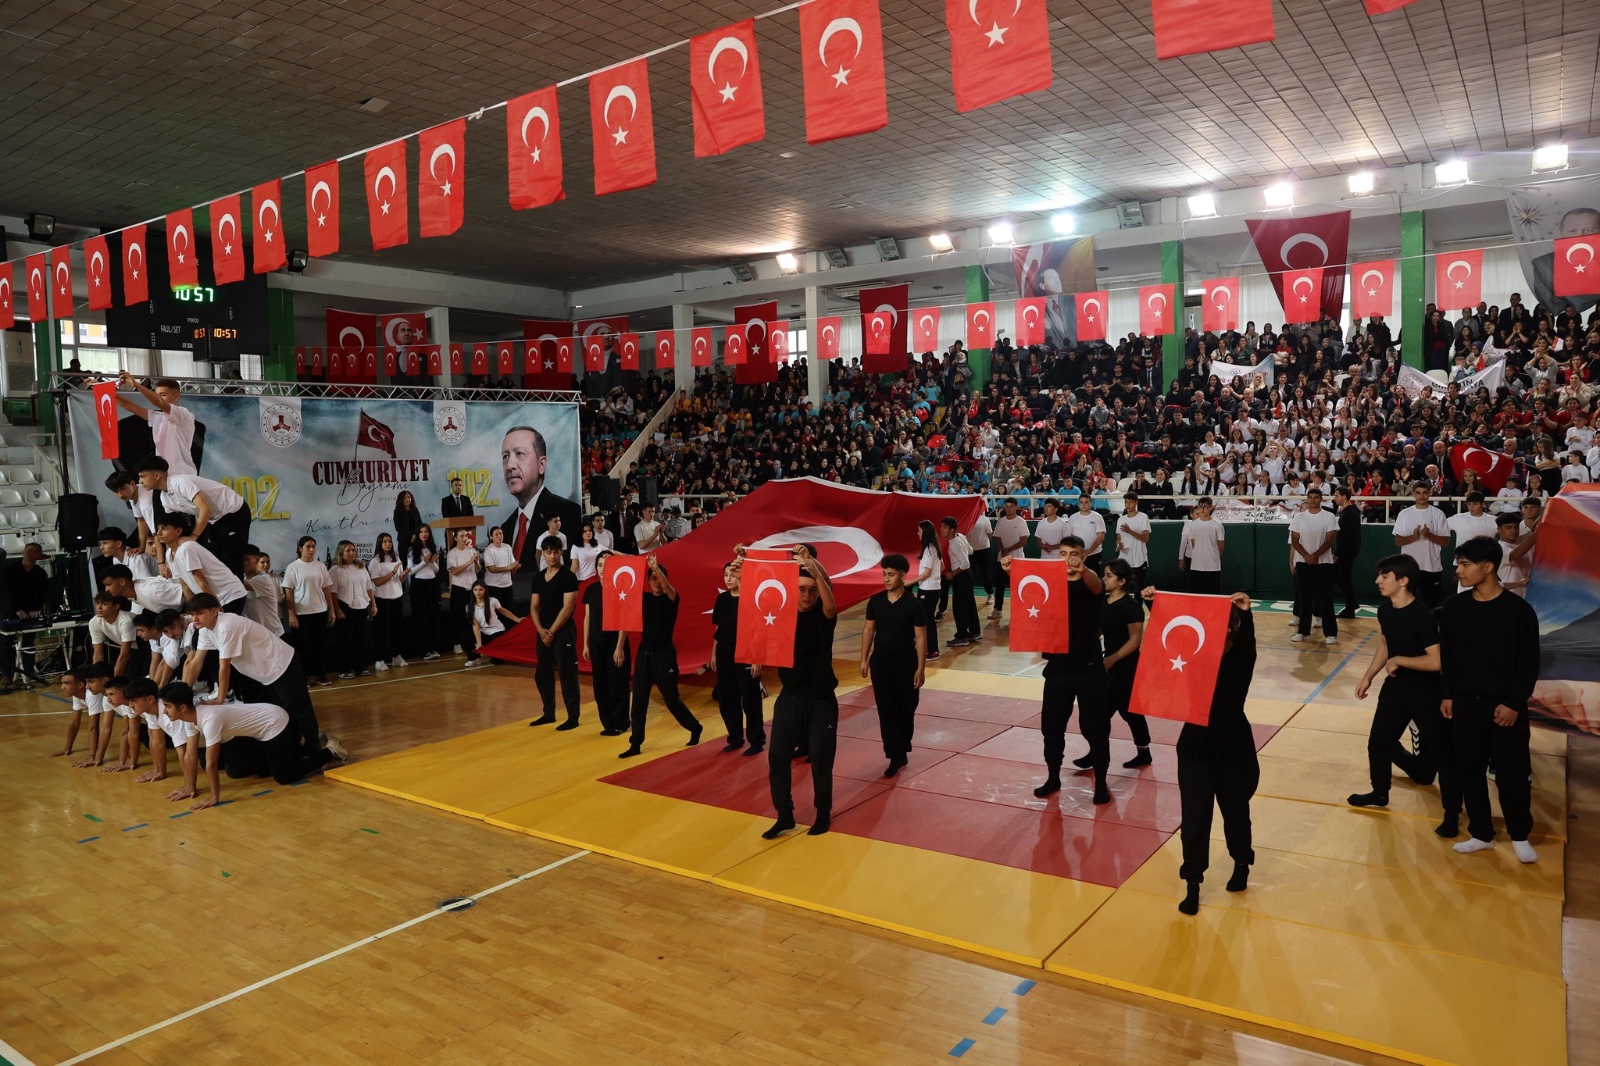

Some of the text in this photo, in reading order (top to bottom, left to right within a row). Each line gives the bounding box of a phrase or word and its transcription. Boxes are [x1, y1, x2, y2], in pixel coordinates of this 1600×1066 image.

[214, 328, 237, 338] 10:57
[312, 459, 430, 486] CUMHURİYET
[219, 475, 290, 521] 02.
